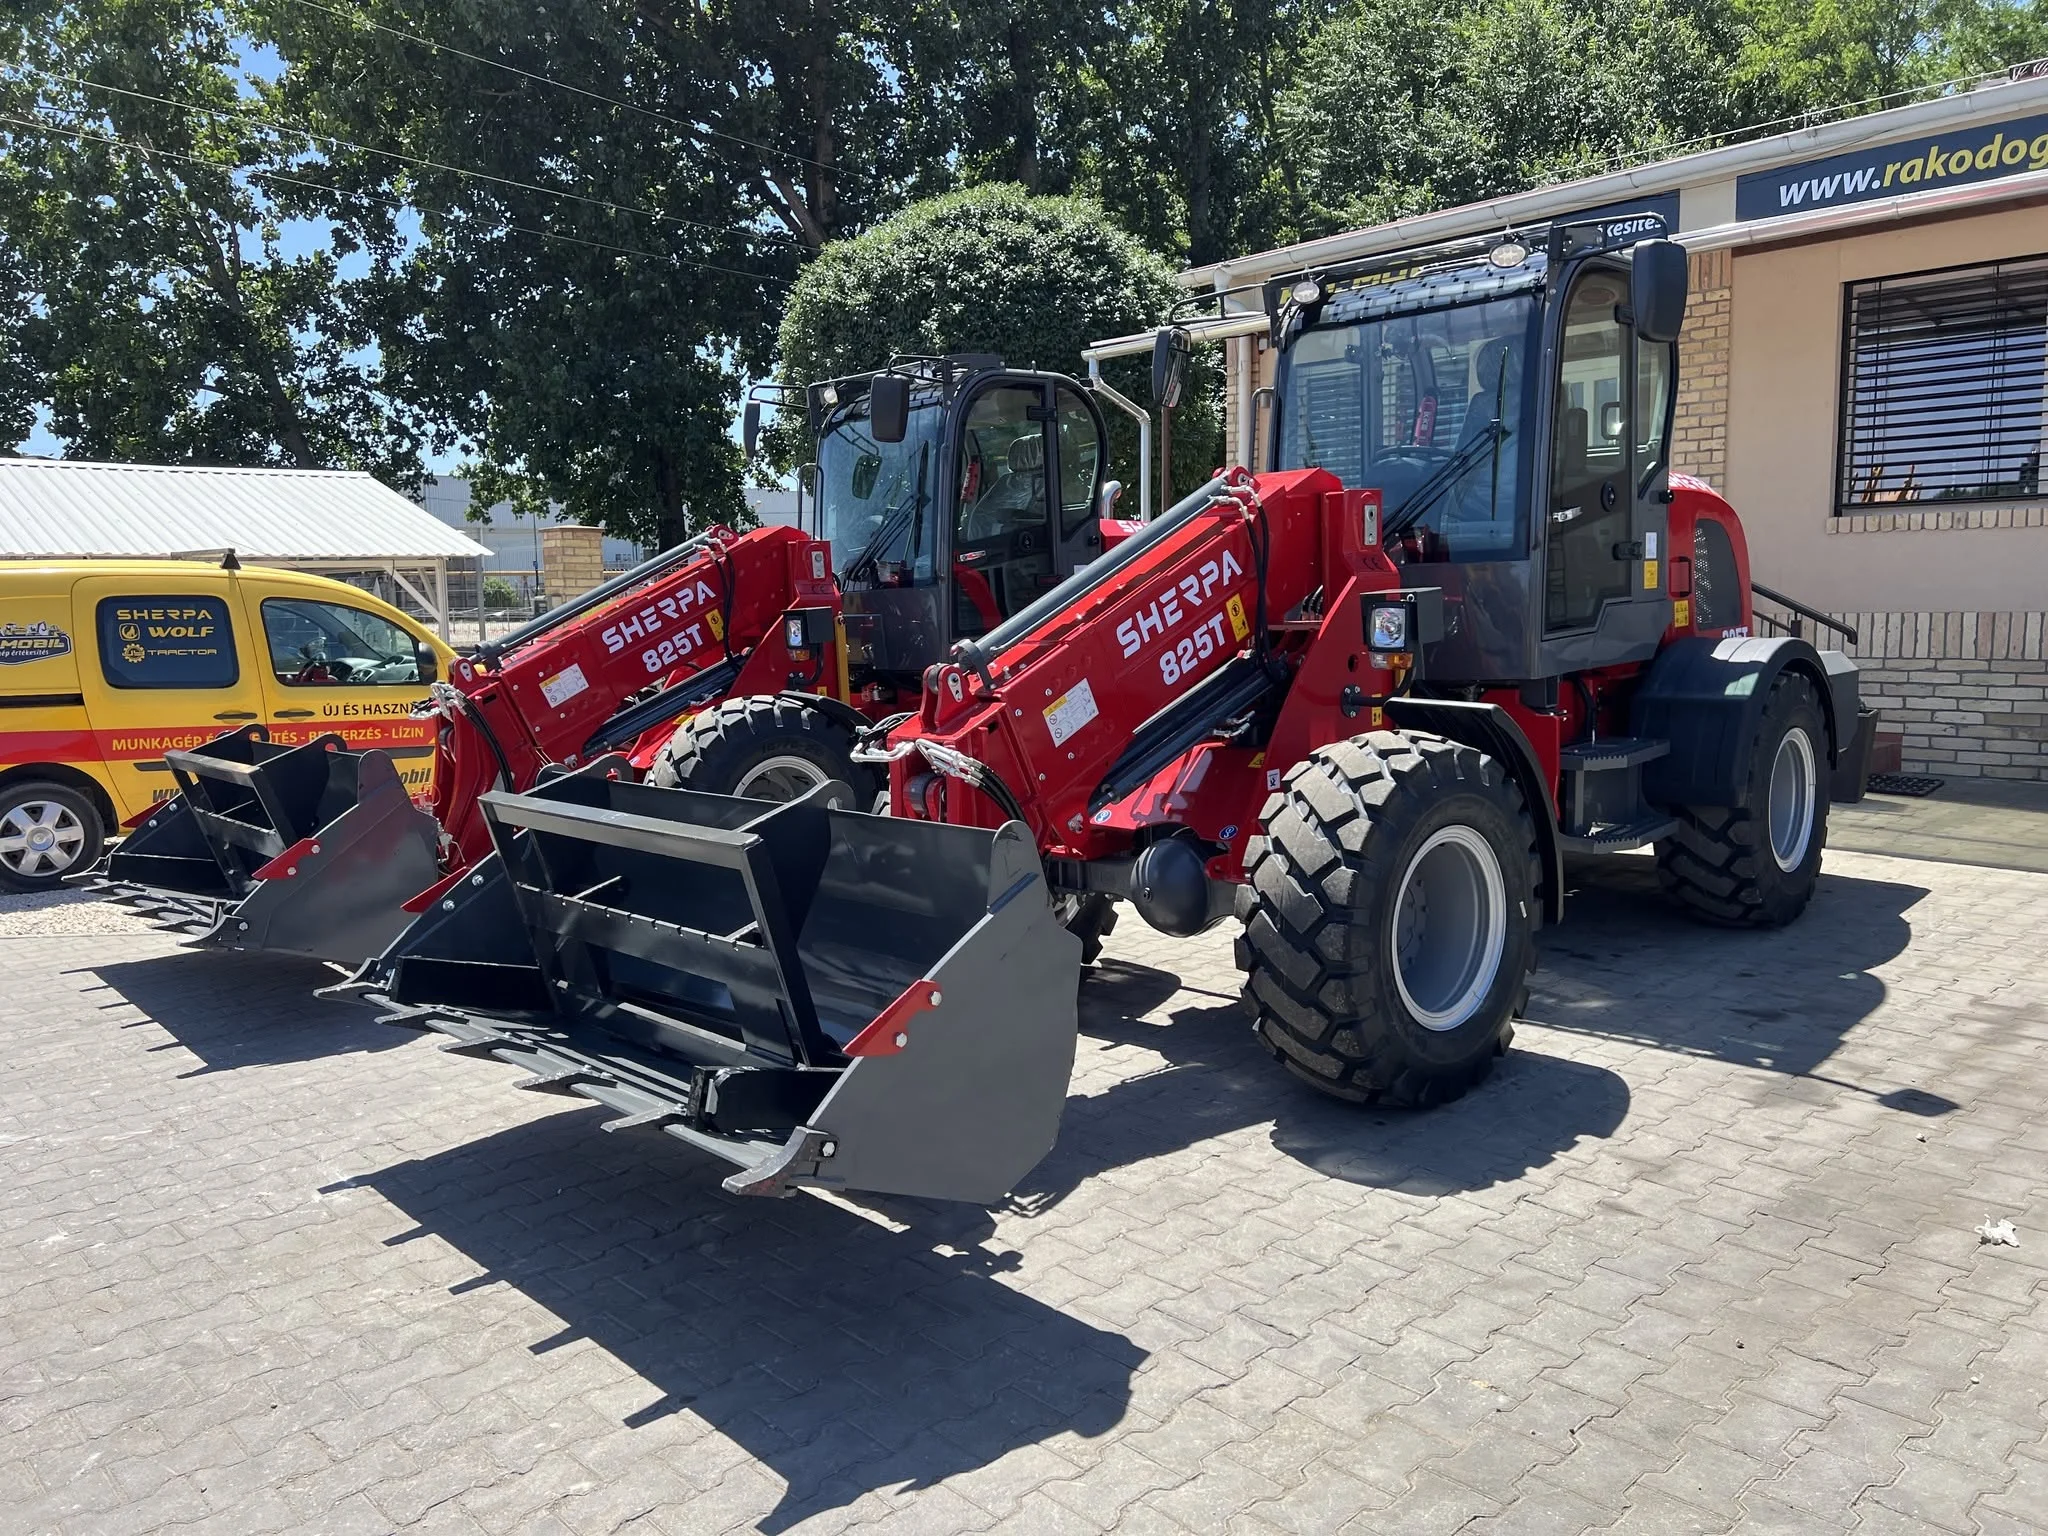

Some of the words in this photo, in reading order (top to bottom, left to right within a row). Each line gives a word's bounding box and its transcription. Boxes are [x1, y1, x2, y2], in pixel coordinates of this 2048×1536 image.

[1116, 549, 1243, 659] SHERPA
[116, 609, 213, 620] SHERPA
[601, 580, 717, 654] SHERPA
[148, 626, 214, 638] WOLF
[0, 638, 65, 649] MOBIL
[147, 648, 218, 656] TRACTOR
[642, 623, 703, 673] 825T
[1159, 611, 1226, 686] 825T
[323, 703, 339, 716] ÚJ
[343, 702, 359, 716] ÉS
[112, 732, 201, 751] MUNKAGÉP
[392, 726, 424, 739] LÍZIN
